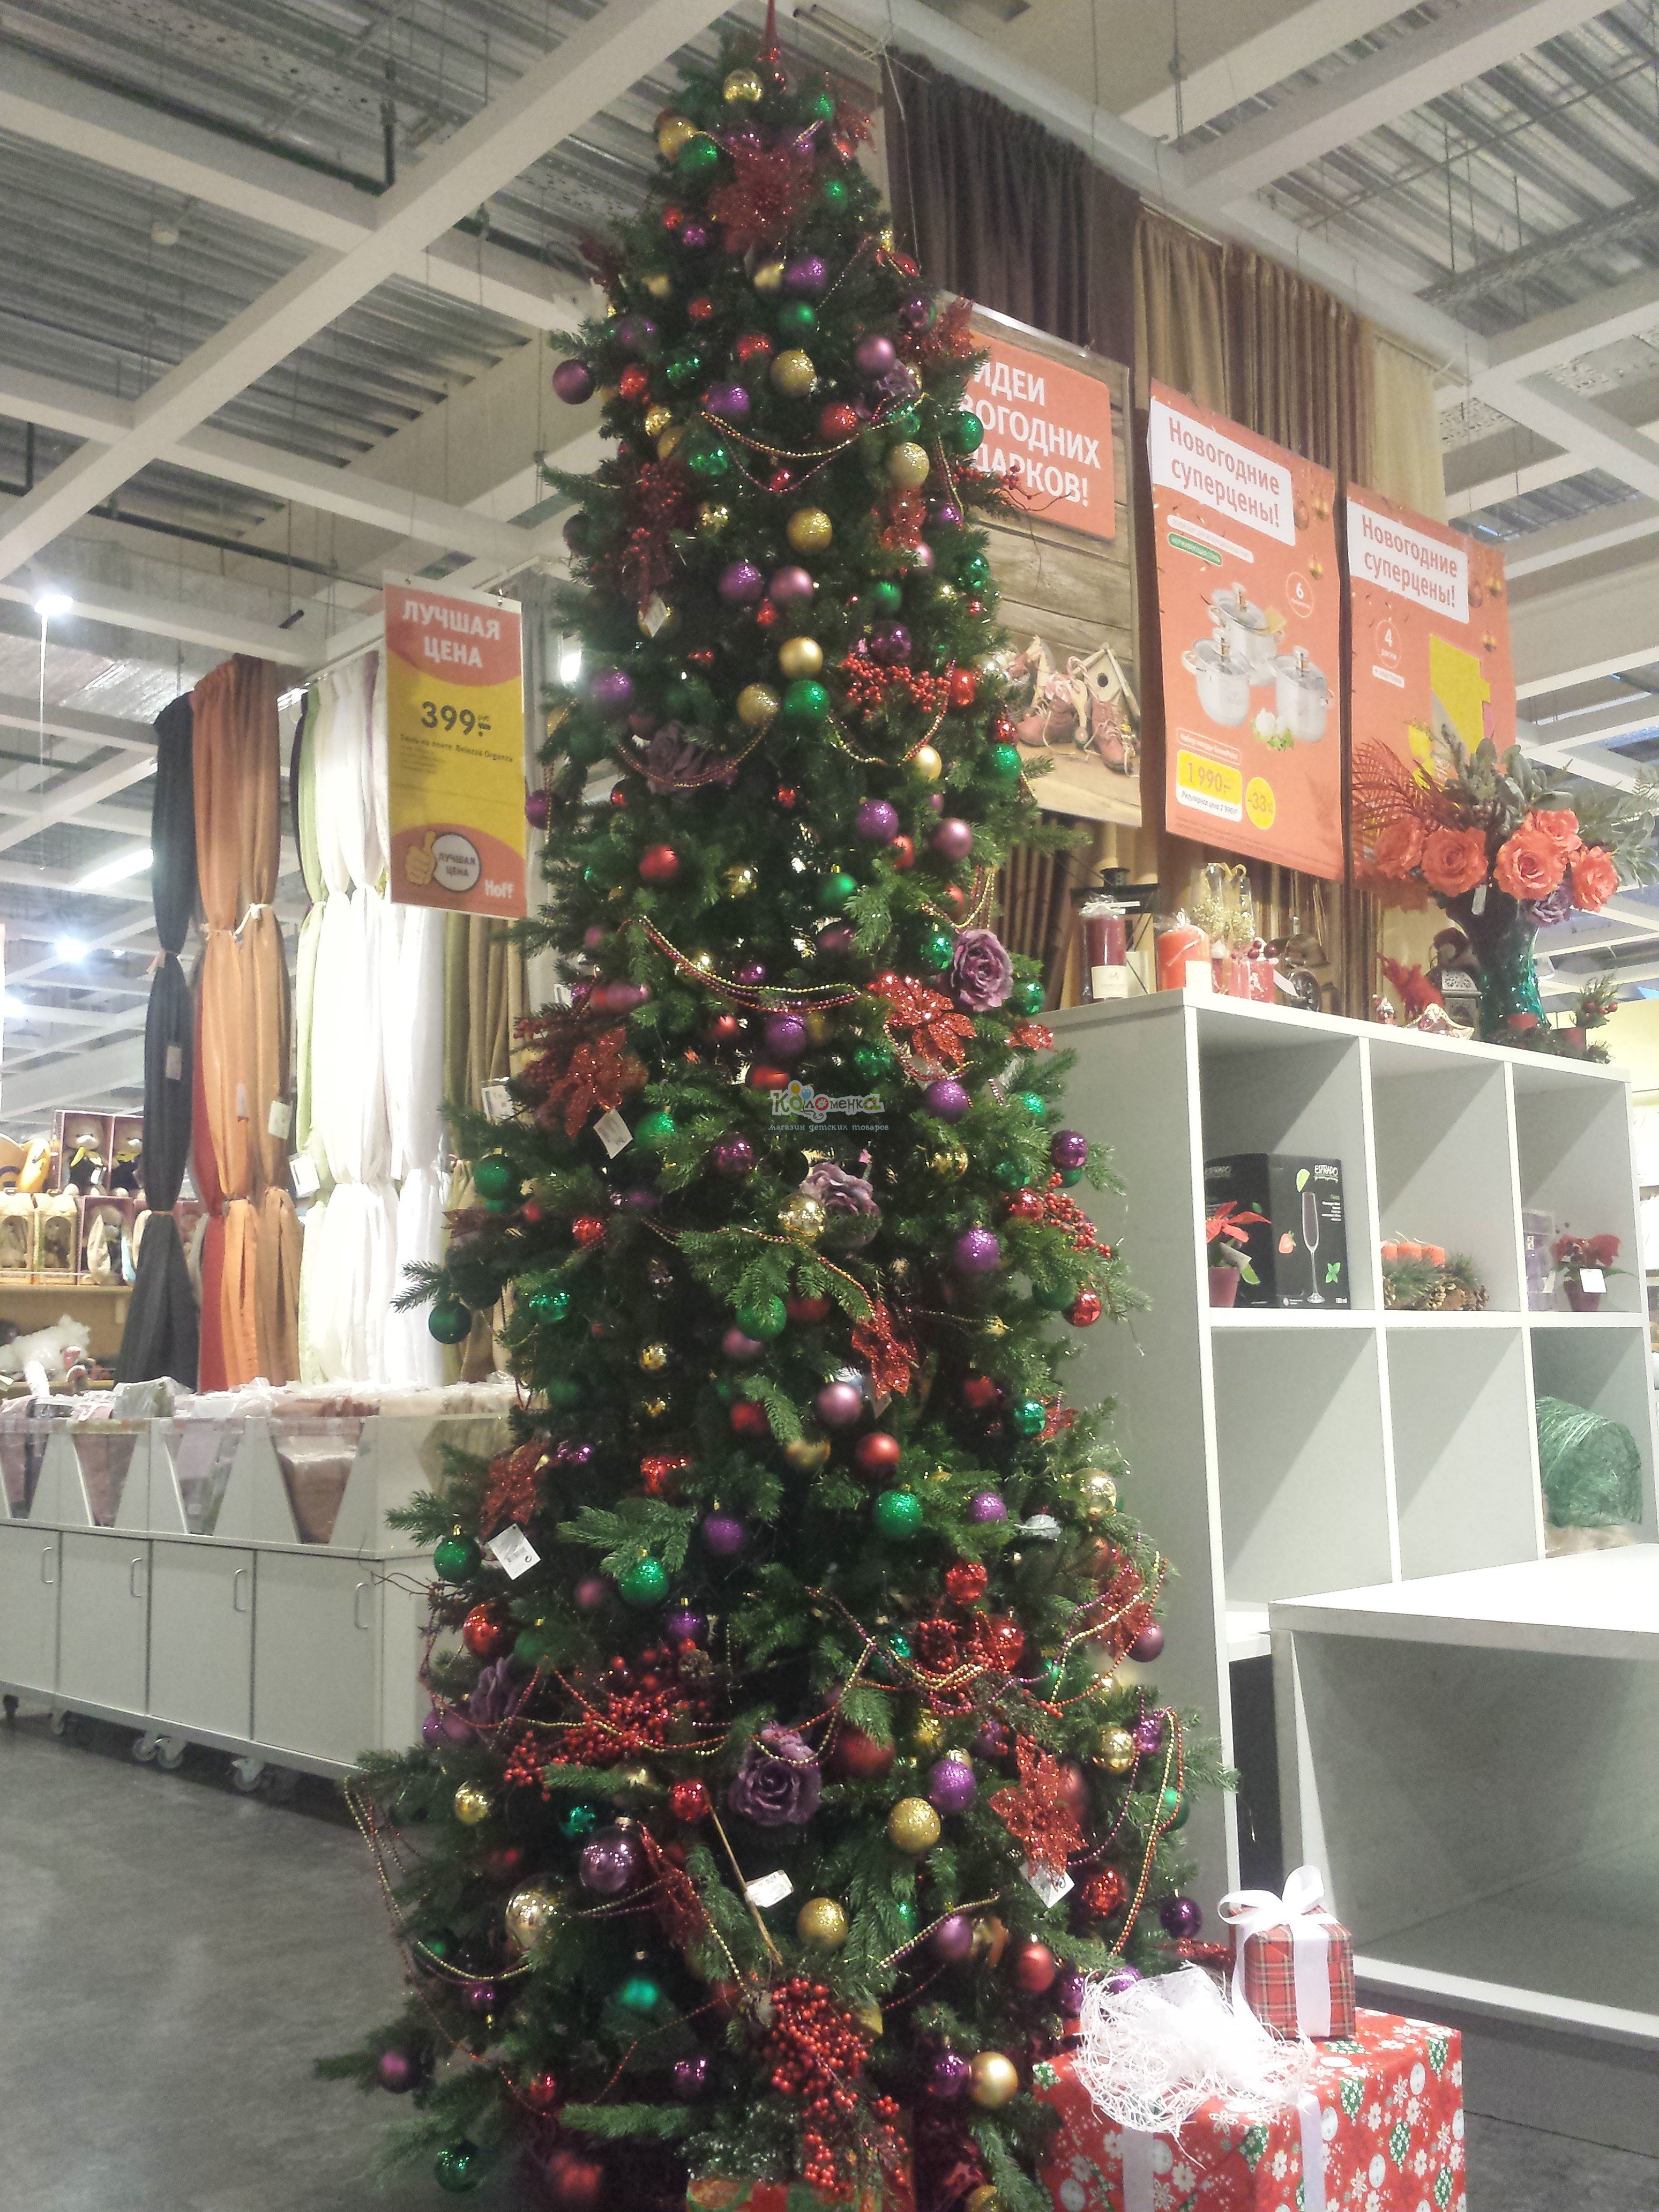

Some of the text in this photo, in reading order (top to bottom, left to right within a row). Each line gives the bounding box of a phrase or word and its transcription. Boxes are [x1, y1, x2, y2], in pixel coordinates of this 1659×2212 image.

[974, 361, 1045, 406] ИДЕИ
[1169, 417, 1280, 495] Новогодние
[1171, 458, 1280, 527] суперцены!
[1362, 514, 1458, 578] Новогодние
[1296, 582, 1304, 599] 6
[1364, 551, 1455, 607] суперцены!
[402, 600, 500, 641] ЛУЧШАЯ
[1385, 628, 1393, 647] 4
[424, 636, 483, 668] ЦЕНА
[439, 853, 475, 865] ЛУЧШАЯ
[484, 879, 514, 899] Hoff
